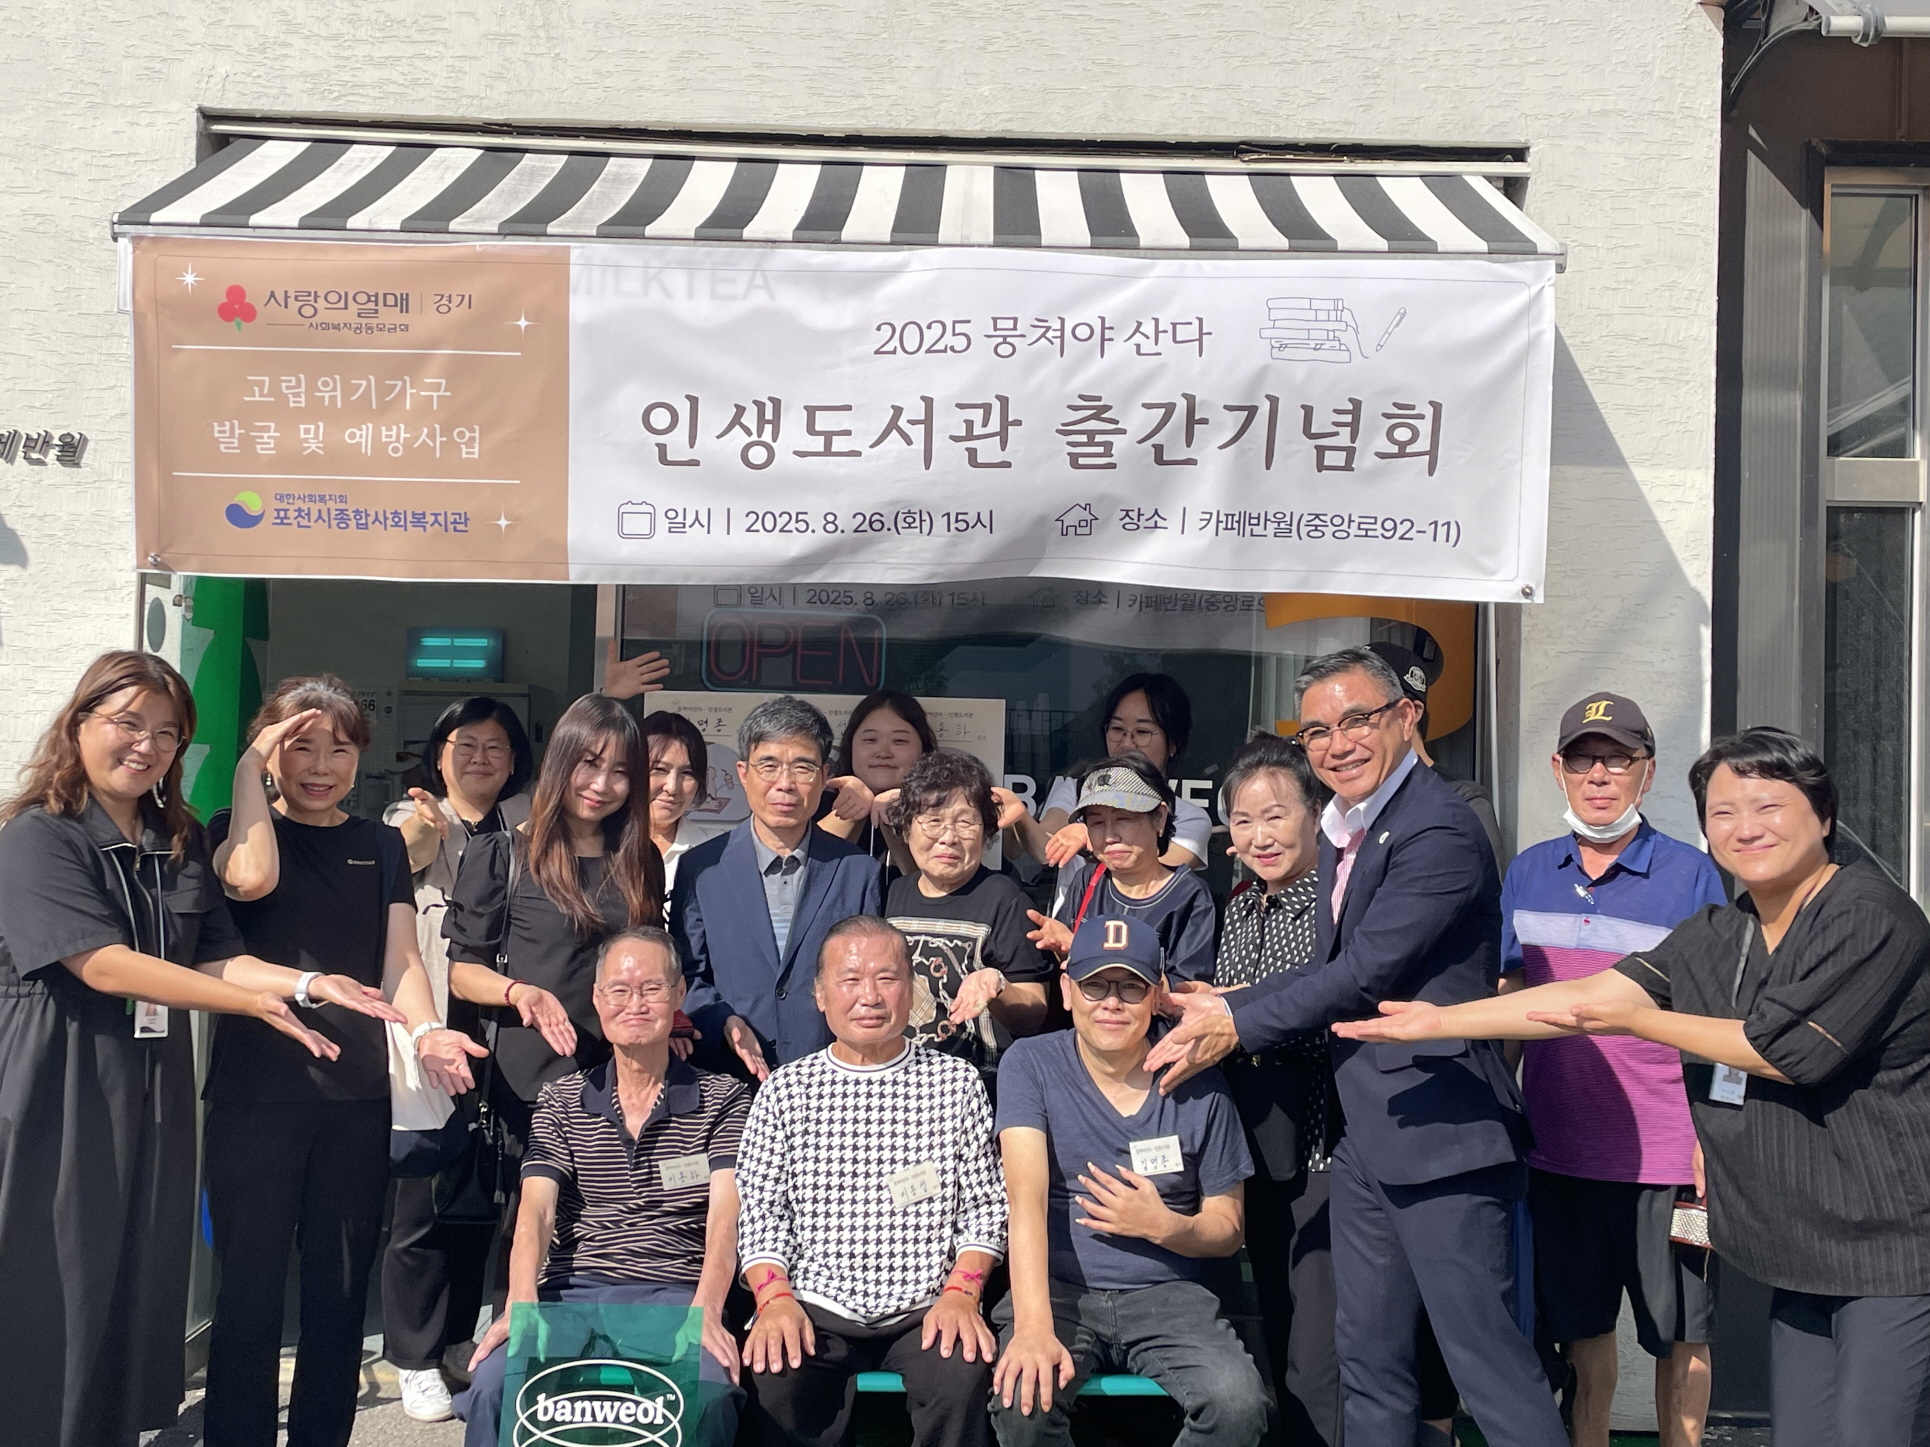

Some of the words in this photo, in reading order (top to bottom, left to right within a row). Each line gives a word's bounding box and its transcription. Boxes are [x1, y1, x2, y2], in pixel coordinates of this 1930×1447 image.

[263, 289, 410, 319] 사랑의열매
[433, 292, 473, 316] 경기
[308, 321, 410, 335] 사회복지공동모금회
[873, 319, 973, 357] 2025
[984, 315, 1115, 359] 뭉쳐야
[1123, 315, 1213, 359] 산다
[243, 373, 452, 411] 고립위기가구
[212, 420, 281, 455] 발굴
[299, 423, 325, 456] 및
[344, 422, 482, 459] 예방사업
[641, 393, 1024, 471] 인생도서관
[1055, 392, 1444, 478] 출간기념회
[274, 492, 349, 506] 대한사회복지회
[272, 506, 471, 534] 포천시종합사회복지관
[663, 507, 712, 536] 일시
[941, 508, 995, 536] 15시
[1118, 506, 1169, 533] 장소
[1198, 509, 1463, 548] 카페반월(중앙로92-11)
[747, 586, 783, 608] 일시
[1073, 590, 1109, 605] 장소
[709, 616, 881, 686] OPEN
[696, 716, 728, 733] 명종
[934, 721, 971, 739] 용하
[1103, 920, 1129, 950] D
[536, 1393, 665, 1425] banweol
